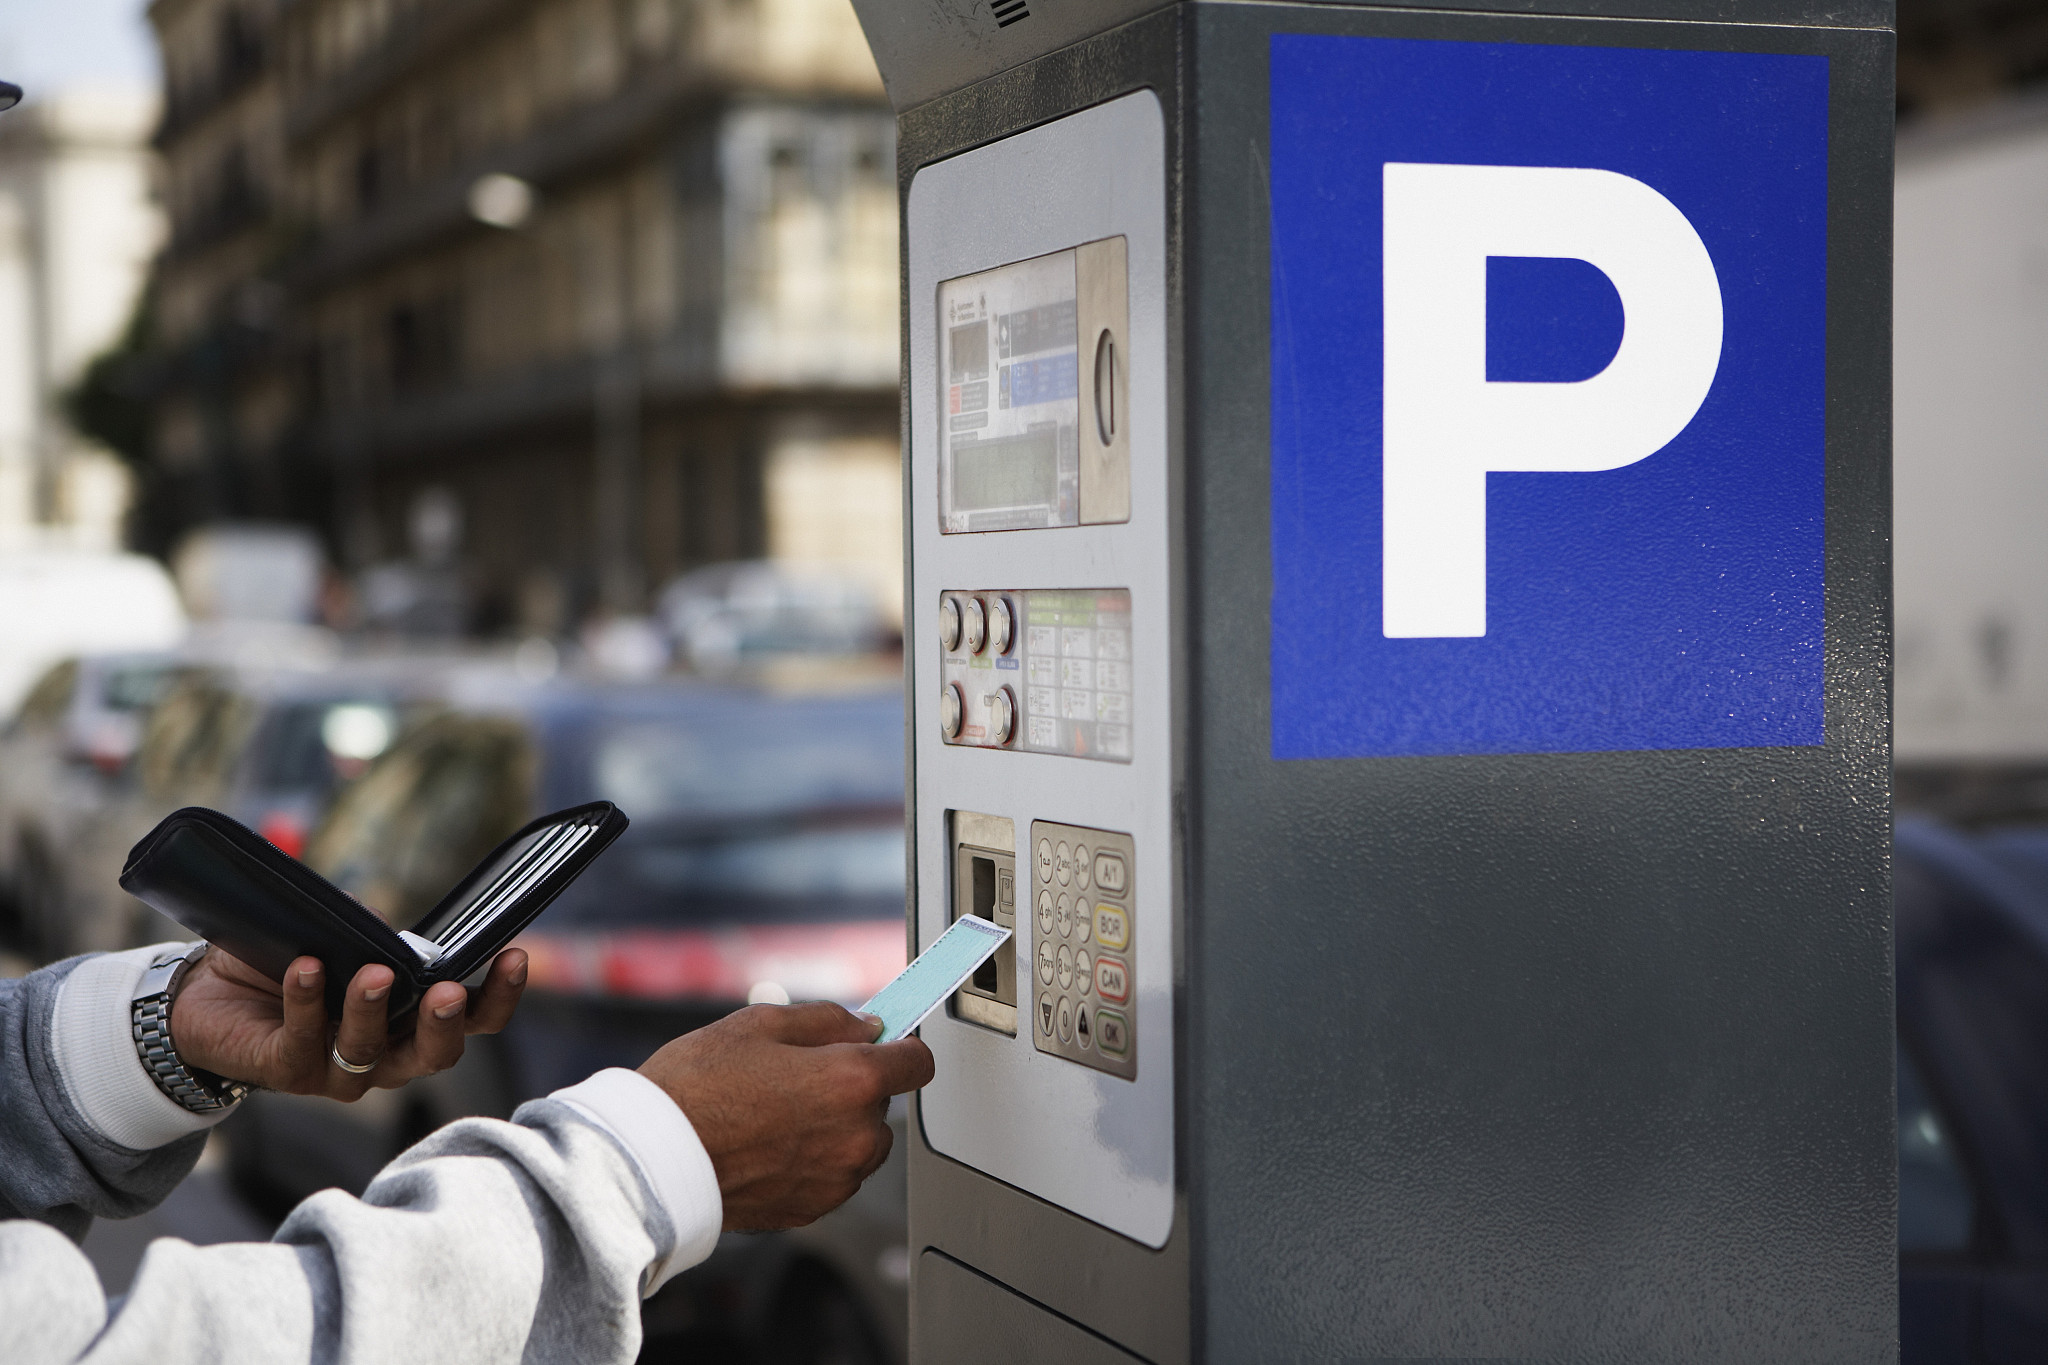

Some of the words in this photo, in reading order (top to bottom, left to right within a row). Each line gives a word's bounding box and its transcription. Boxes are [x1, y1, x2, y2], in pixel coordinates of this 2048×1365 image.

[1383, 162, 1724, 638] P
[1075, 858, 1080, 875] 3
[1039, 904, 1044, 920] 4
[1057, 906, 1062, 923] 5
[1101, 916, 1120, 936] BOR
[1039, 953, 1044, 969] 7
[1058, 958, 1063, 975] 8
[1102, 970, 1121, 990] CAN
[1105, 1022, 1119, 1042] OK
